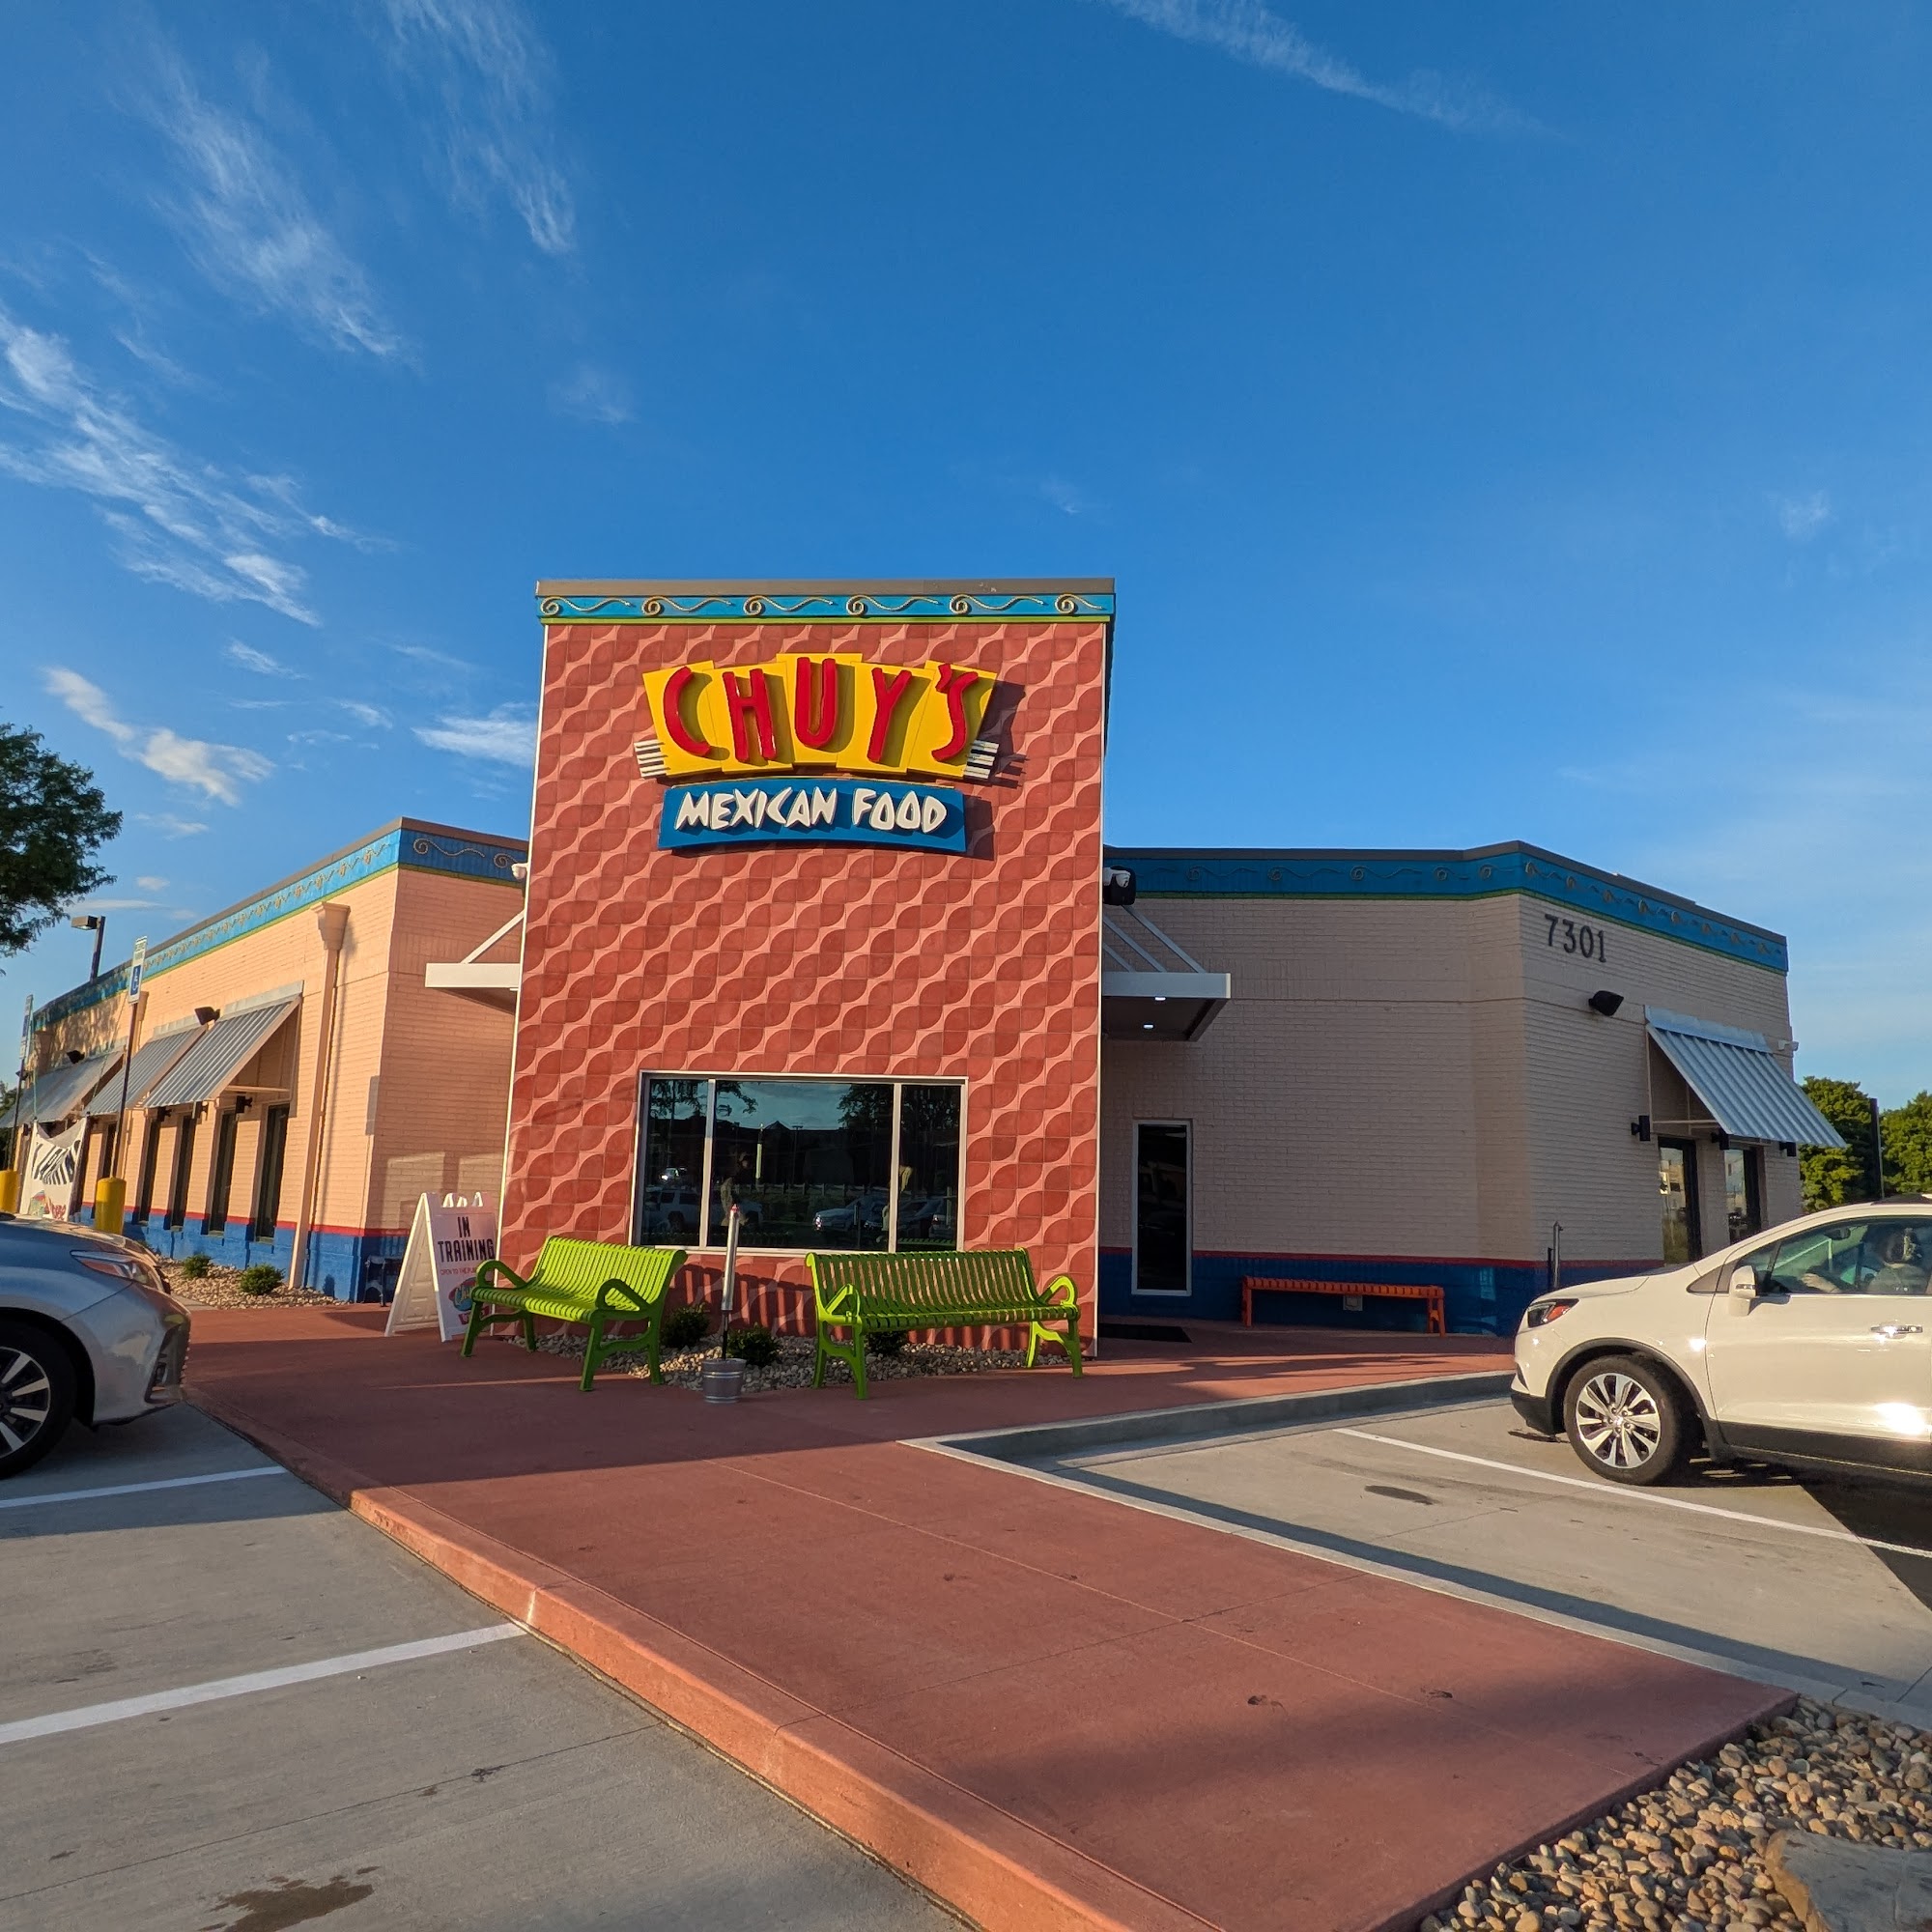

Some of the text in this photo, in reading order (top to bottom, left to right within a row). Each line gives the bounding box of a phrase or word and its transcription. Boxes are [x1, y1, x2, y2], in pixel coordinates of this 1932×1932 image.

[663, 657, 979, 763] CHUY'S
[675, 786, 947, 834] MEXICAN FOOD
[1544, 913, 1607, 963] 7301
[438, 1238, 495, 1263] TRAINING
[458, 1216, 470, 1237] IN
